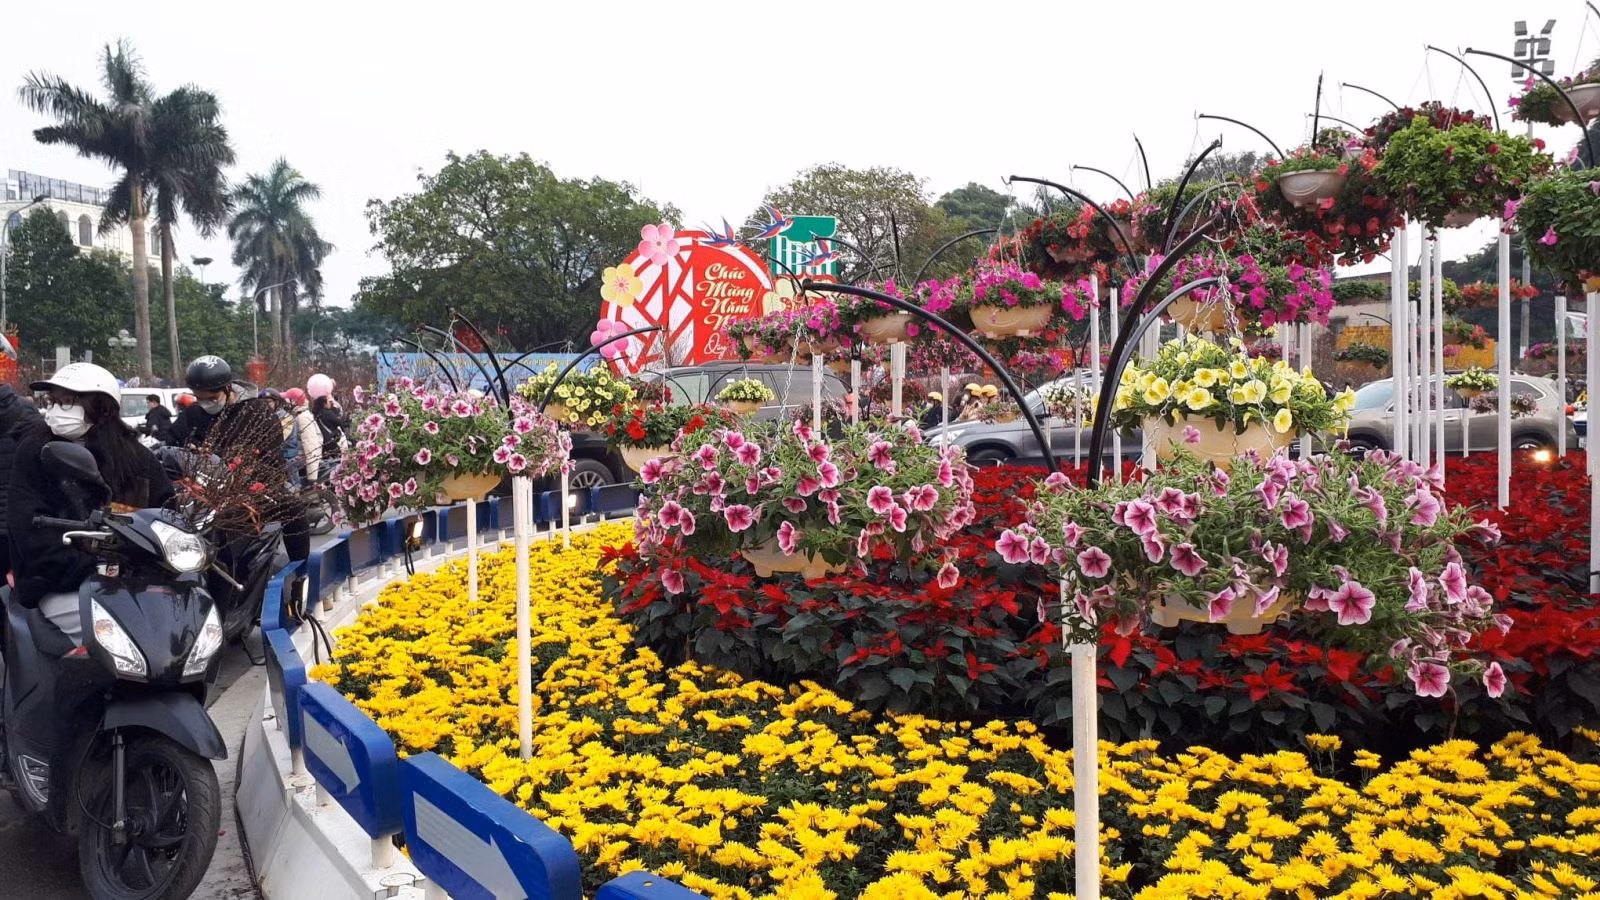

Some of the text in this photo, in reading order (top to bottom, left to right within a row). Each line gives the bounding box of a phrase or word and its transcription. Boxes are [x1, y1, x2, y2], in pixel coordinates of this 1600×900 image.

[705, 263, 745, 280] Chúc
[697, 281, 754, 303] Mừng
[702, 298, 750, 314] Năm
